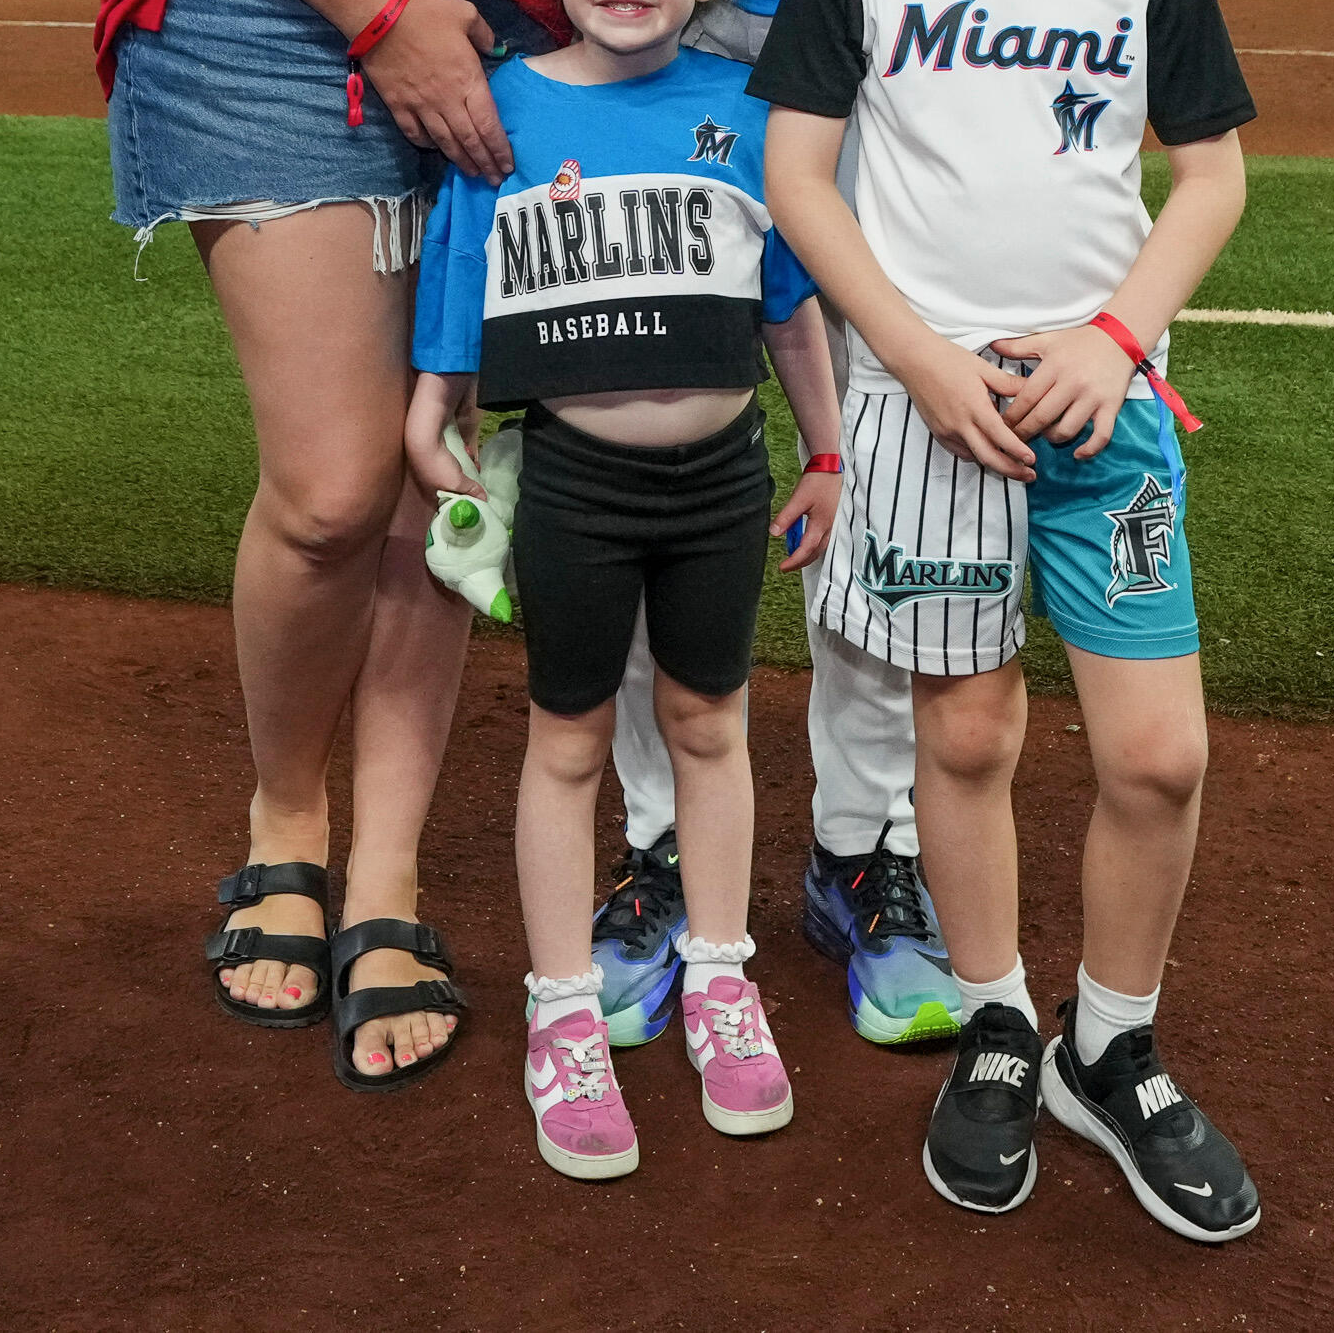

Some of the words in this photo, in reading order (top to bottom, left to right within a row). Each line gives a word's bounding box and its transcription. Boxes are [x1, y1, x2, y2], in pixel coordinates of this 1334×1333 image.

[883, 0, 1134, 78] Miami
[497, 187, 716, 299] MARLINS
[537, 311, 667, 346] BASEBALL
[968, 1052, 1029, 1088] NIKE
[1134, 1073, 1183, 1121] NIKE
